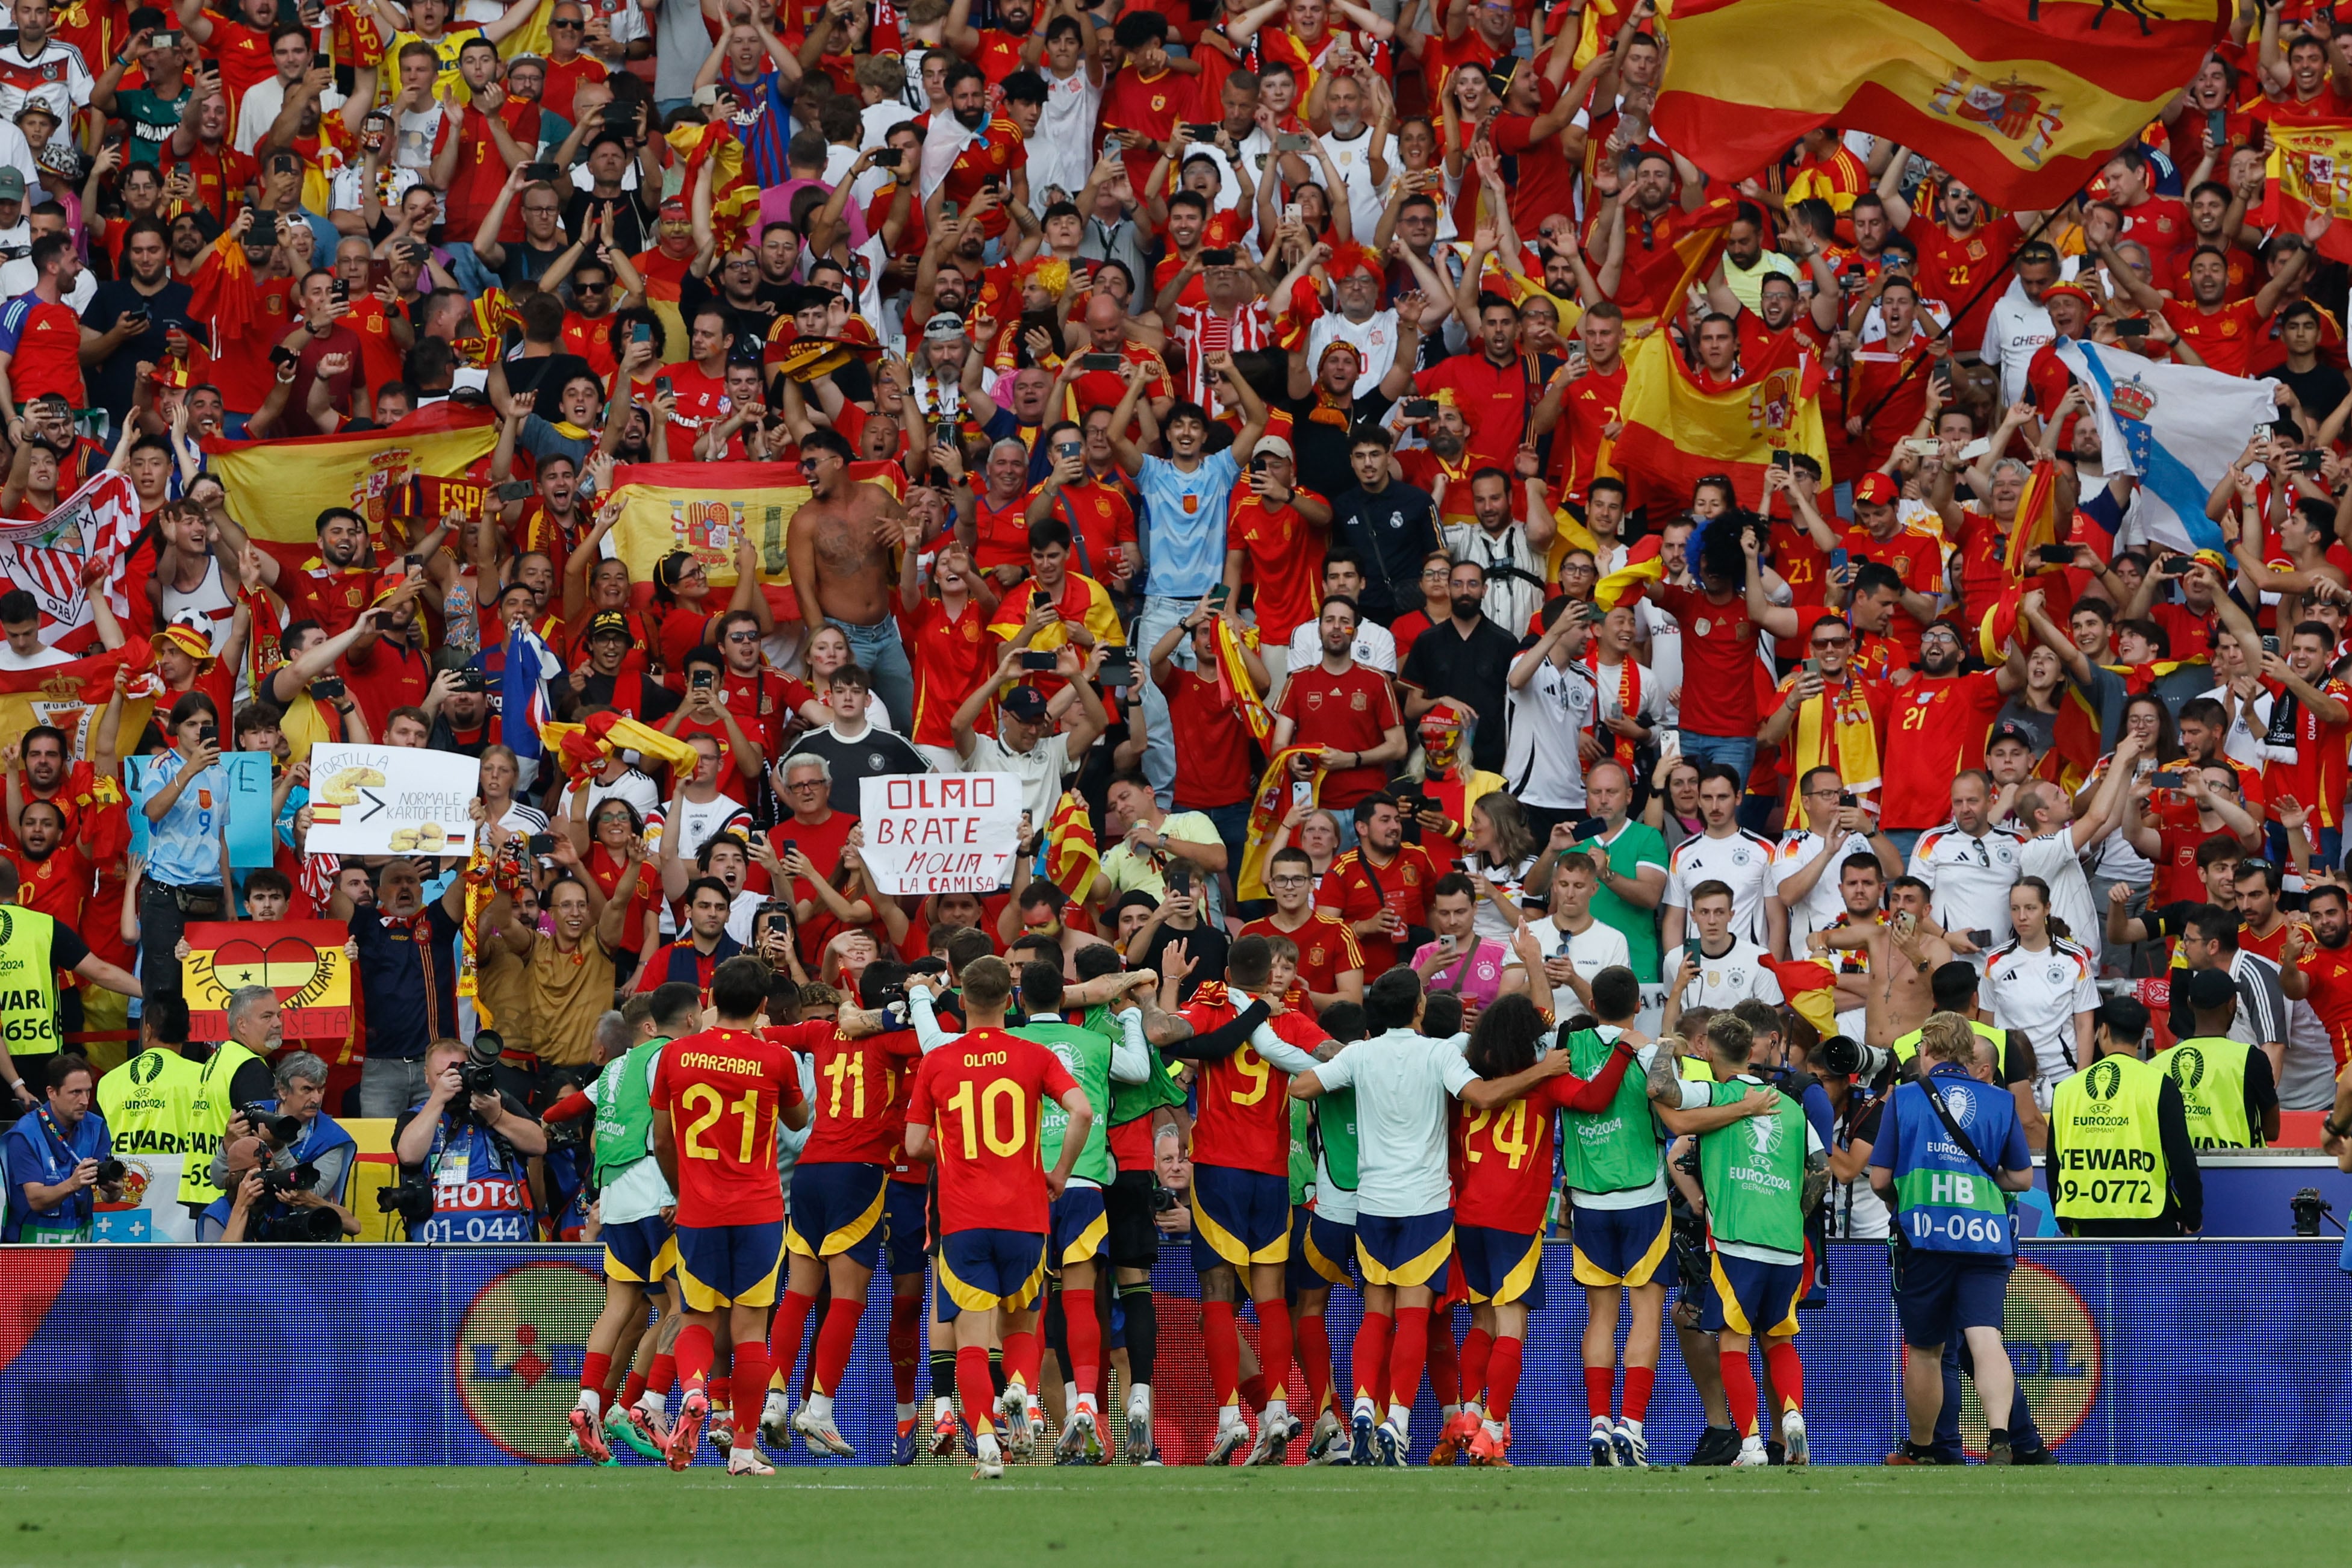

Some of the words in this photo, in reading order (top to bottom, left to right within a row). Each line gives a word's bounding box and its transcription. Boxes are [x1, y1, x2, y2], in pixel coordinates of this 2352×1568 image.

[477, 142, 486, 164] 5
[1949, 265, 1970, 284] 22
[1788, 558, 1813, 584] 21
[1903, 707, 1927, 730] 21
[313, 753, 389, 779] TORTILLA
[399, 792, 462, 806] NORMALE
[888, 778, 994, 809] OLMO
[199, 812, 211, 836] 9
[877, 817, 980, 844] BRATE
[905, 850, 982, 874] MOLIM
[900, 877, 918, 892] LA
[928, 877, 994, 892] CAMISA
[284, 951, 337, 1011] WILLIAMS
[5, 1018, 52, 1041] 656
[281, 1012, 349, 1036] ISETA
[680, 1052, 764, 1077] OYARZABAL
[963, 1051, 1007, 1068] OLMO
[823, 1050, 864, 1119] 11
[1231, 1039, 1270, 1106] 9
[948, 1077, 1026, 1159] 10
[2073, 1116, 2129, 1125] EURO2024
[2090, 1104, 2112, 1114] UEFA
[682, 1083, 758, 1163] 21
[1463, 1100, 1529, 1169] 24
[2061, 1148, 2156, 1174] TEWARD
[1729, 1166, 1792, 1192] EURO2024
[1741, 1183, 1776, 1196] GERMANY
[1930, 1174, 1975, 1205] HB
[423, 1217, 520, 1243] 01-044
